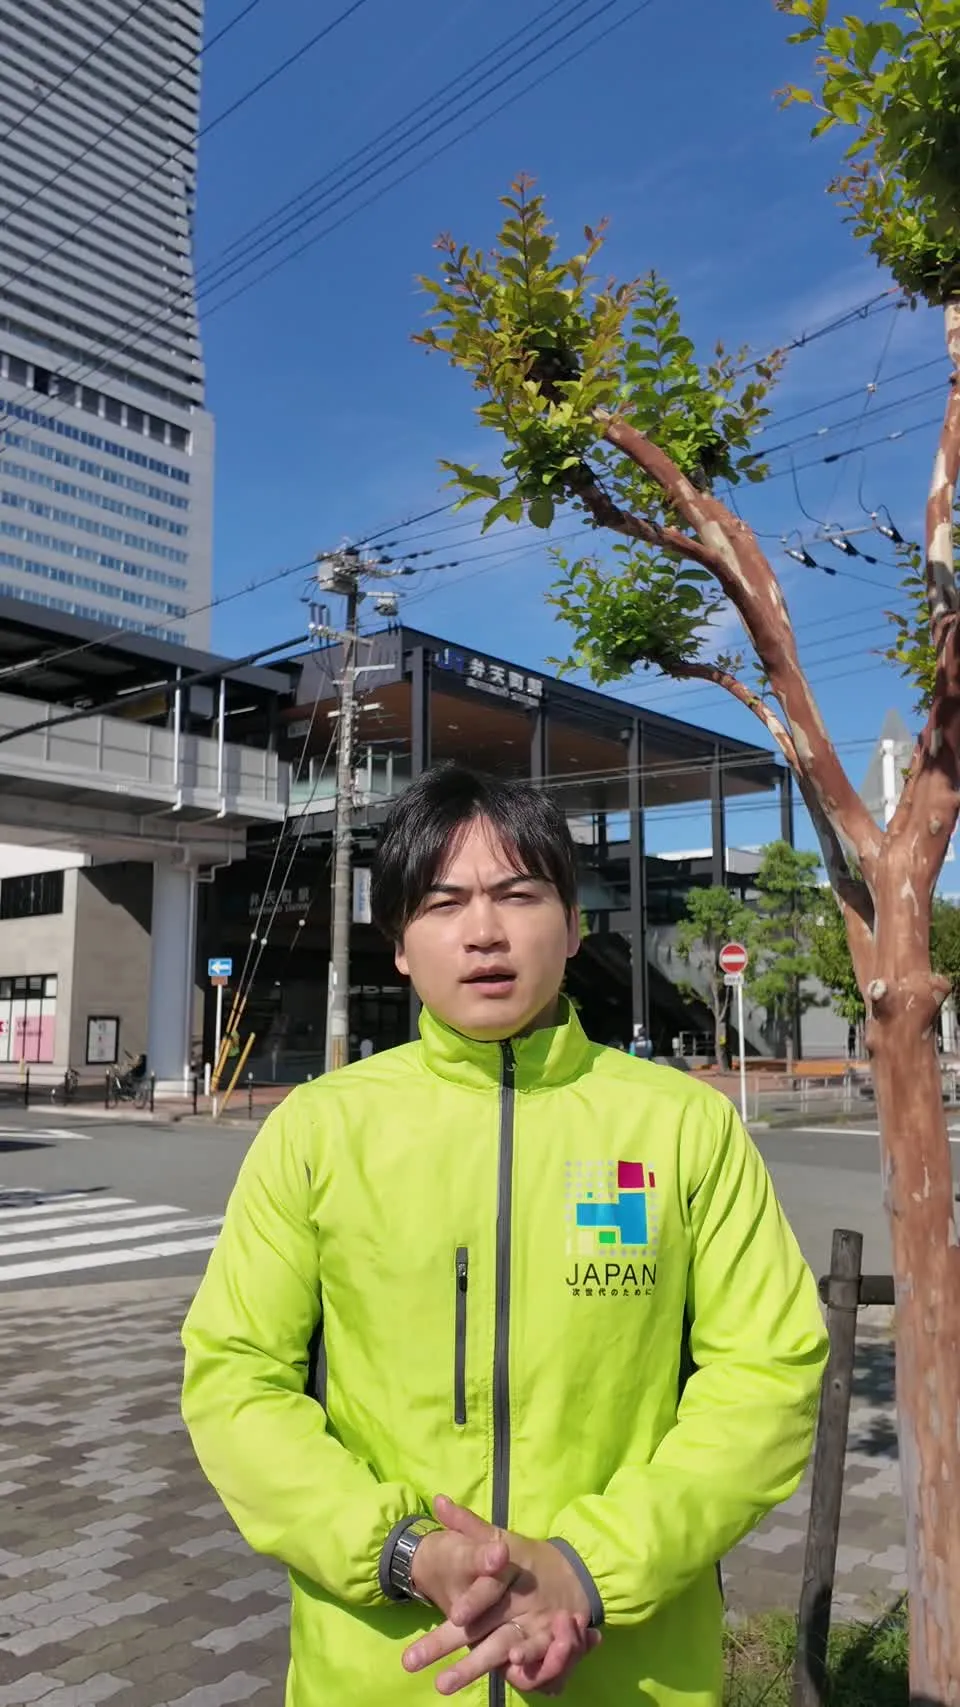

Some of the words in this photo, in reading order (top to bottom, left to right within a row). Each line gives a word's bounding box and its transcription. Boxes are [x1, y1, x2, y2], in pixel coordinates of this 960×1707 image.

[566, 1263, 657, 1286] JAPAN
[572, 1288, 652, 1297] 次世代のために
